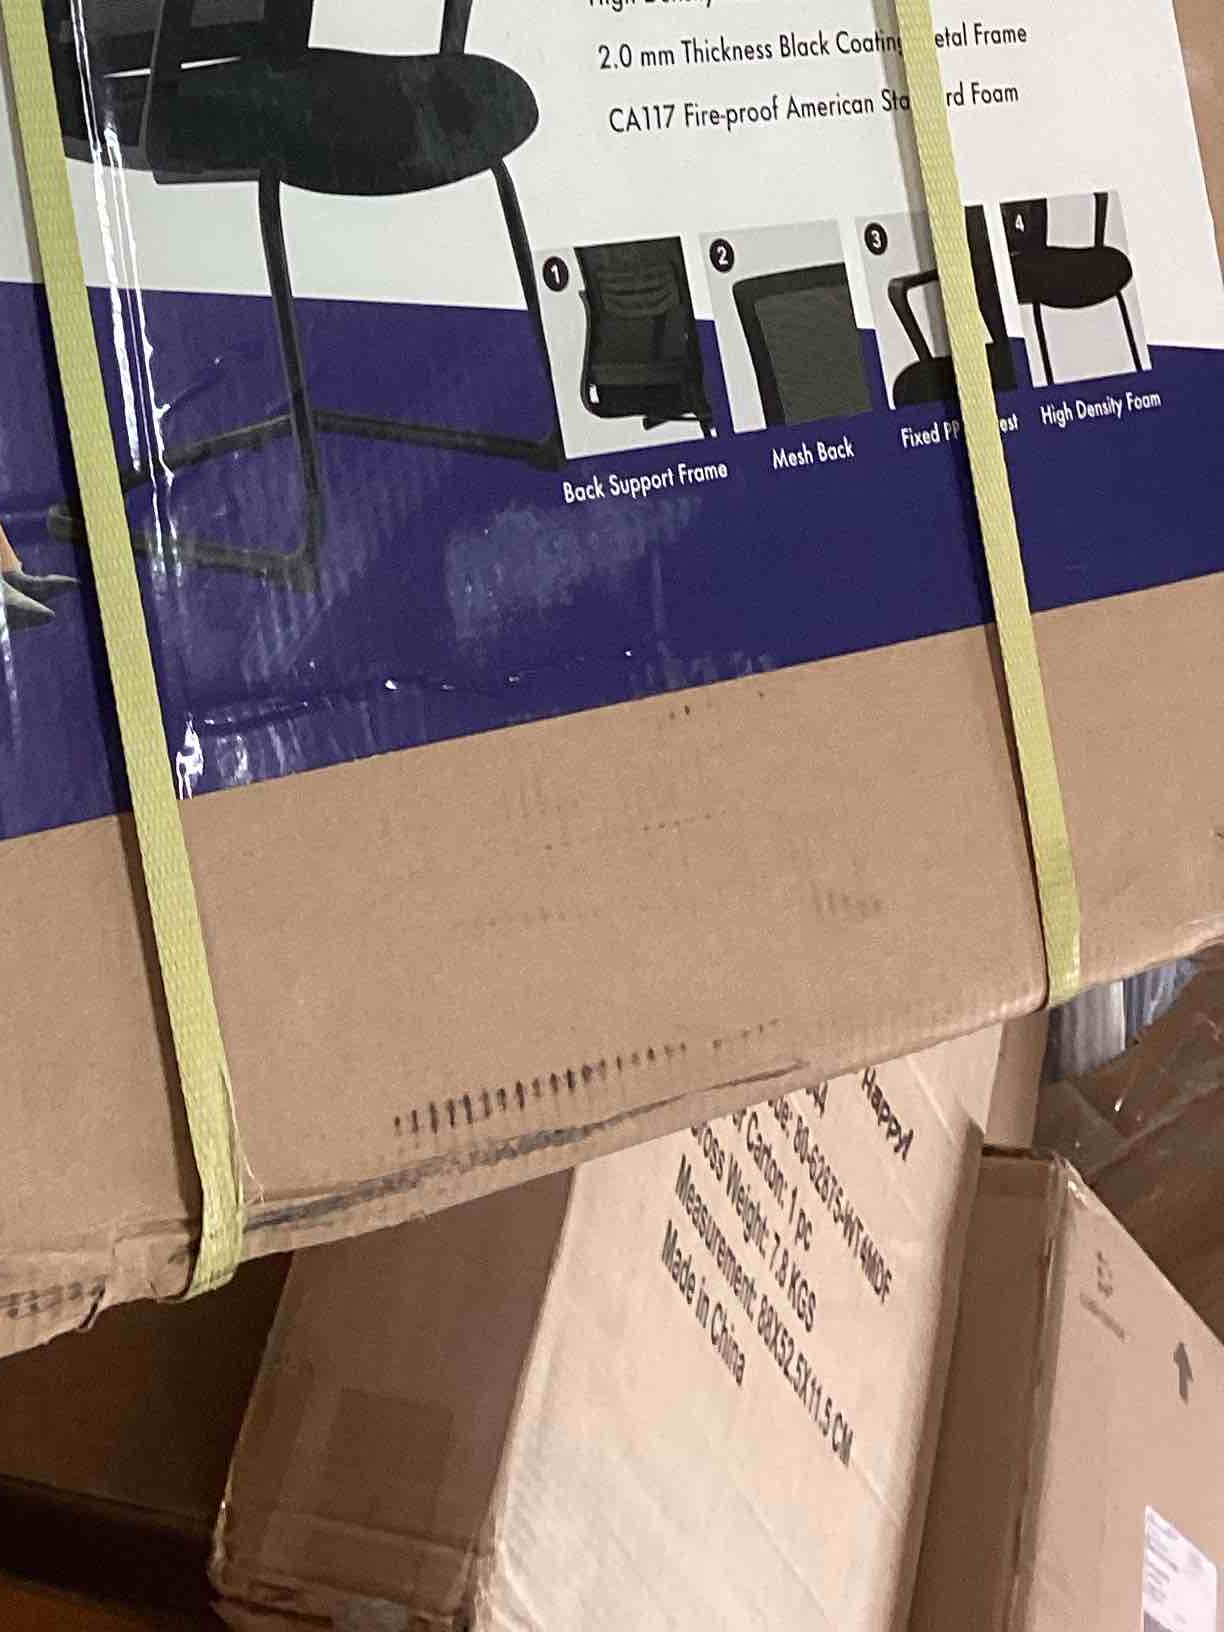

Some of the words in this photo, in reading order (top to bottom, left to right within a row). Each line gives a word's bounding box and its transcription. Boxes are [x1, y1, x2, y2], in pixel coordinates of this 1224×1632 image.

[599, 43, 632, 70] 2.0
[641, 53, 675, 68] mm
[681, 35, 774, 65] Thickness
[780, 29, 830, 58] Black
[933, 22, 968, 49] etal
[974, 22, 1027, 46] Frame
[609, 104, 676, 133] CA117
[684, 95, 778, 132] Fire-proof
[785, 93, 874, 121] American
[971, 82, 1019, 106] Foam
[870, 229, 883, 250] 3
[1013, 213, 1025, 233] 4
[550, 264, 562, 285] 1
[715, 245, 730, 266] 2
[1040, 404, 1074, 429] High
[1075, 396, 1123, 420] Density
[1126, 391, 1162, 412] Foam
[772, 443, 814, 470] Mesh
[817, 436, 855, 462] Back
[901, 422, 940, 449] Fixed
[562, 476, 605, 504] Back
[609, 467, 674, 502] Support
[678, 461, 728, 486] Frame
[746, 1111, 789, 1210] Carton:
[795, 1208, 813, 1252] pc
[726, 1152, 770, 1260] Weight:
[787, 1262, 817, 1334] KGS
[662, 1218, 697, 1305] Made
[695, 1276, 711, 1329] in
[710, 1302, 747, 1388] China
[675, 1153, 758, 1323] Measurement:
[831, 1412, 855, 1469] CM
